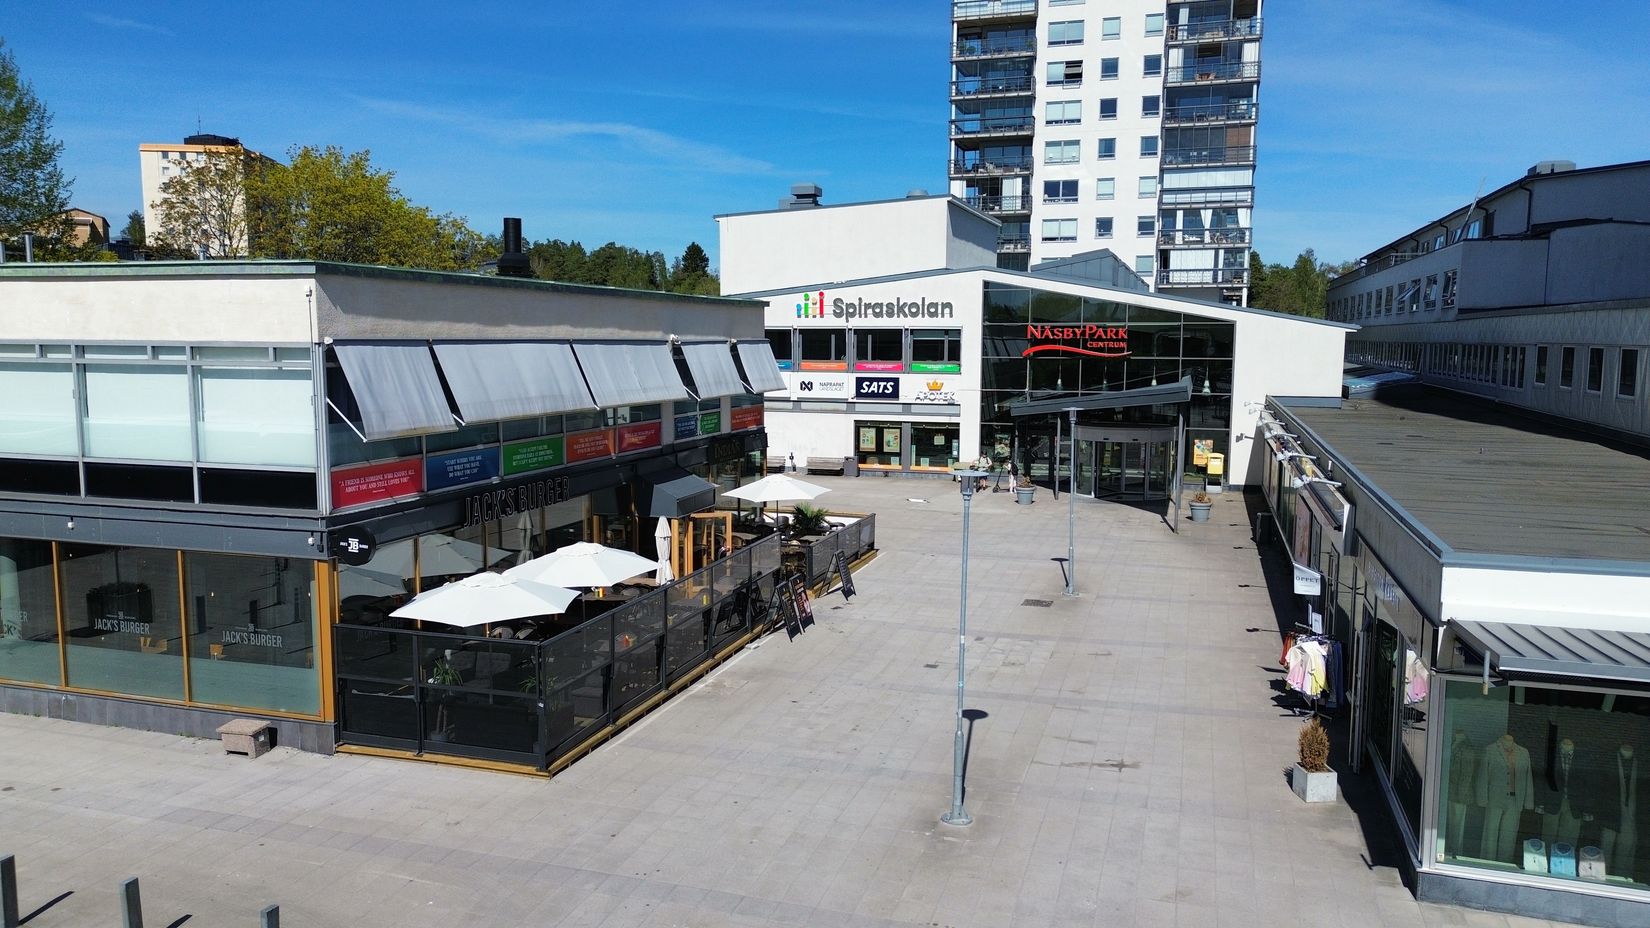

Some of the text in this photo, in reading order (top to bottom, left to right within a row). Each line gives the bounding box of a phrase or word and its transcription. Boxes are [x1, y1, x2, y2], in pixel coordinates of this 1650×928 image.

[832, 297, 953, 323] Spiraskolan
[860, 381, 895, 394] SATS
[914, 391, 956, 402] APOTEK
[464, 476, 570, 528] JACK'S BURGER
[94, 618, 150, 635] JACK'S BURGER
[221, 630, 283, 648] JACK'S BURGER
